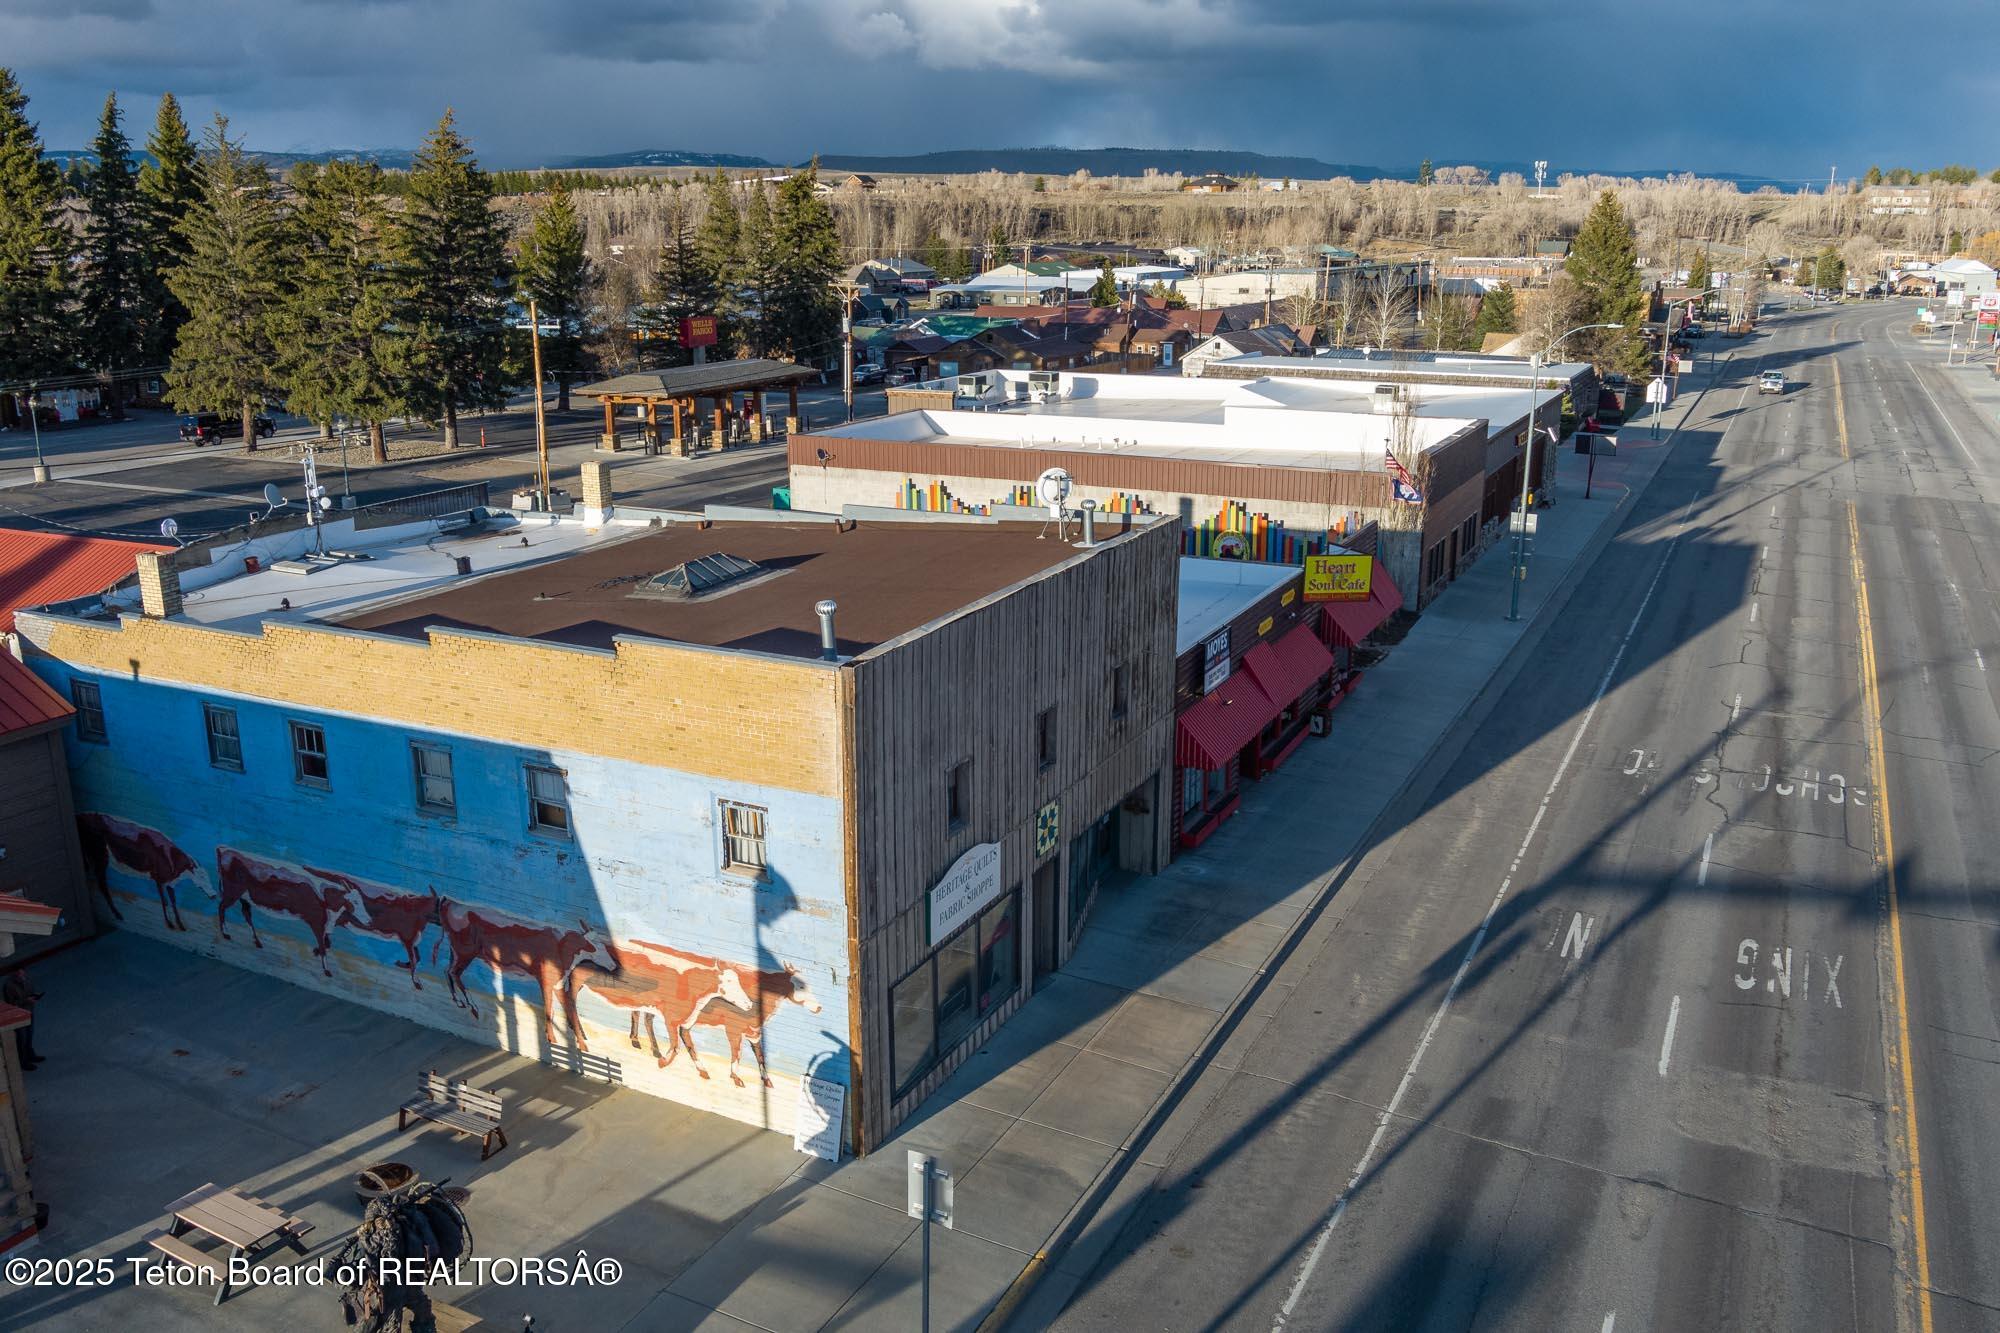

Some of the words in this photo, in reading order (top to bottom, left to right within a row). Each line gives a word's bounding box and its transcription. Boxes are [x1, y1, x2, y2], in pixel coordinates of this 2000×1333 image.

[692, 319, 713, 328] WELLS
[693, 327, 713, 336] FARGO
[1314, 559, 1356, 574] Heart
[1309, 575, 1335, 591] Soul
[935, 866, 974, 903] HERITAGE
[973, 847, 998, 876] QUILTS
[939, 895, 966, 926] FABRIC
[966, 873, 994, 905] SHOPPE
[1734, 938, 1843, 1009] XING
